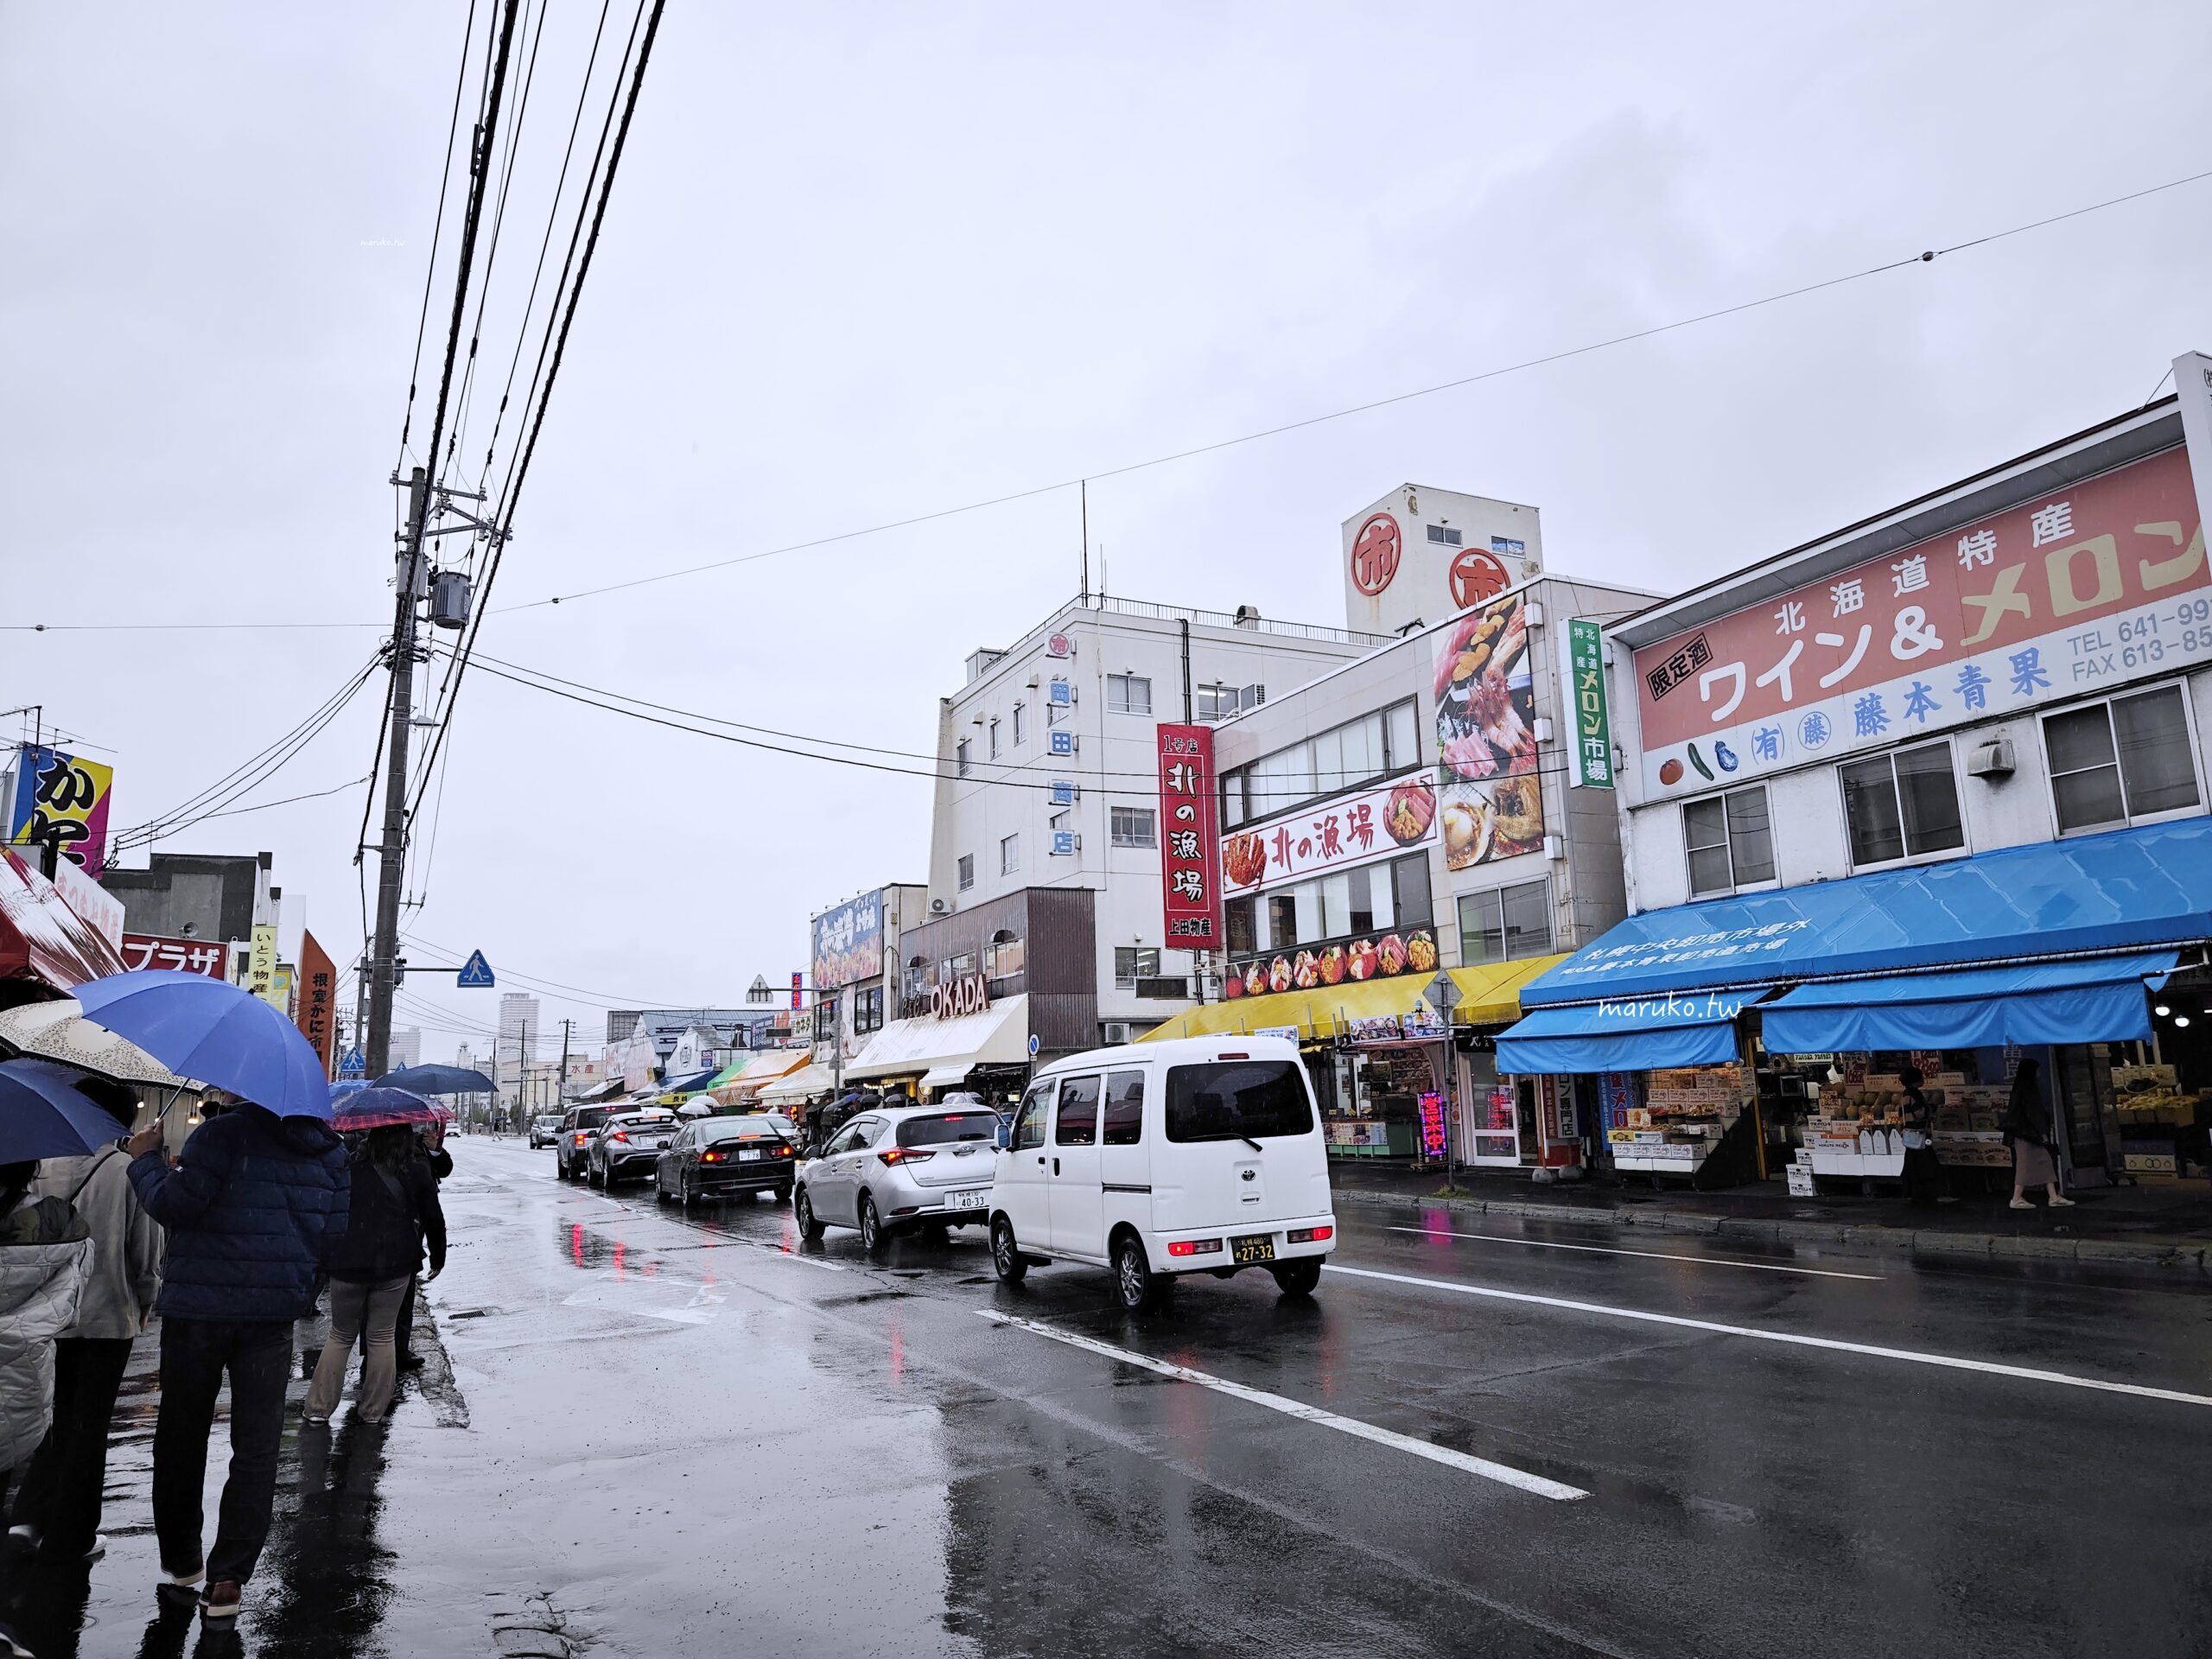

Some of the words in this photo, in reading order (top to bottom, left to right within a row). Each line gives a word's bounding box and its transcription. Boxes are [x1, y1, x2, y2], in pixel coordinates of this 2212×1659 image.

[1774, 500, 2076, 637] 北海道特産
[1586, 628, 1598, 669] 北海道
[2067, 631, 2112, 656] TEL
[2118, 598, 2212, 643] 641-99
[1649, 638, 1709, 696] 限定酒
[1855, 647, 2053, 738] 藤本青果
[2072, 653, 2116, 682] FAX
[1163, 735, 1198, 753] 1号店
[1580, 671, 1608, 781] メロン市場
[1166, 760, 1204, 903] 北の漁場
[1271, 804, 1374, 874] 北の漁場
[1168, 918, 1212, 937] 上田物産
[252, 933, 271, 1001] いとう物産
[931, 974, 987, 1019] OKADA
[571, 1064, 594, 1074] 水産
[1424, 1096, 1444, 1151] 営業中
[962, 1197, 984, 1207] 40-33
[1242, 1244, 1274, 1261] 27-32
